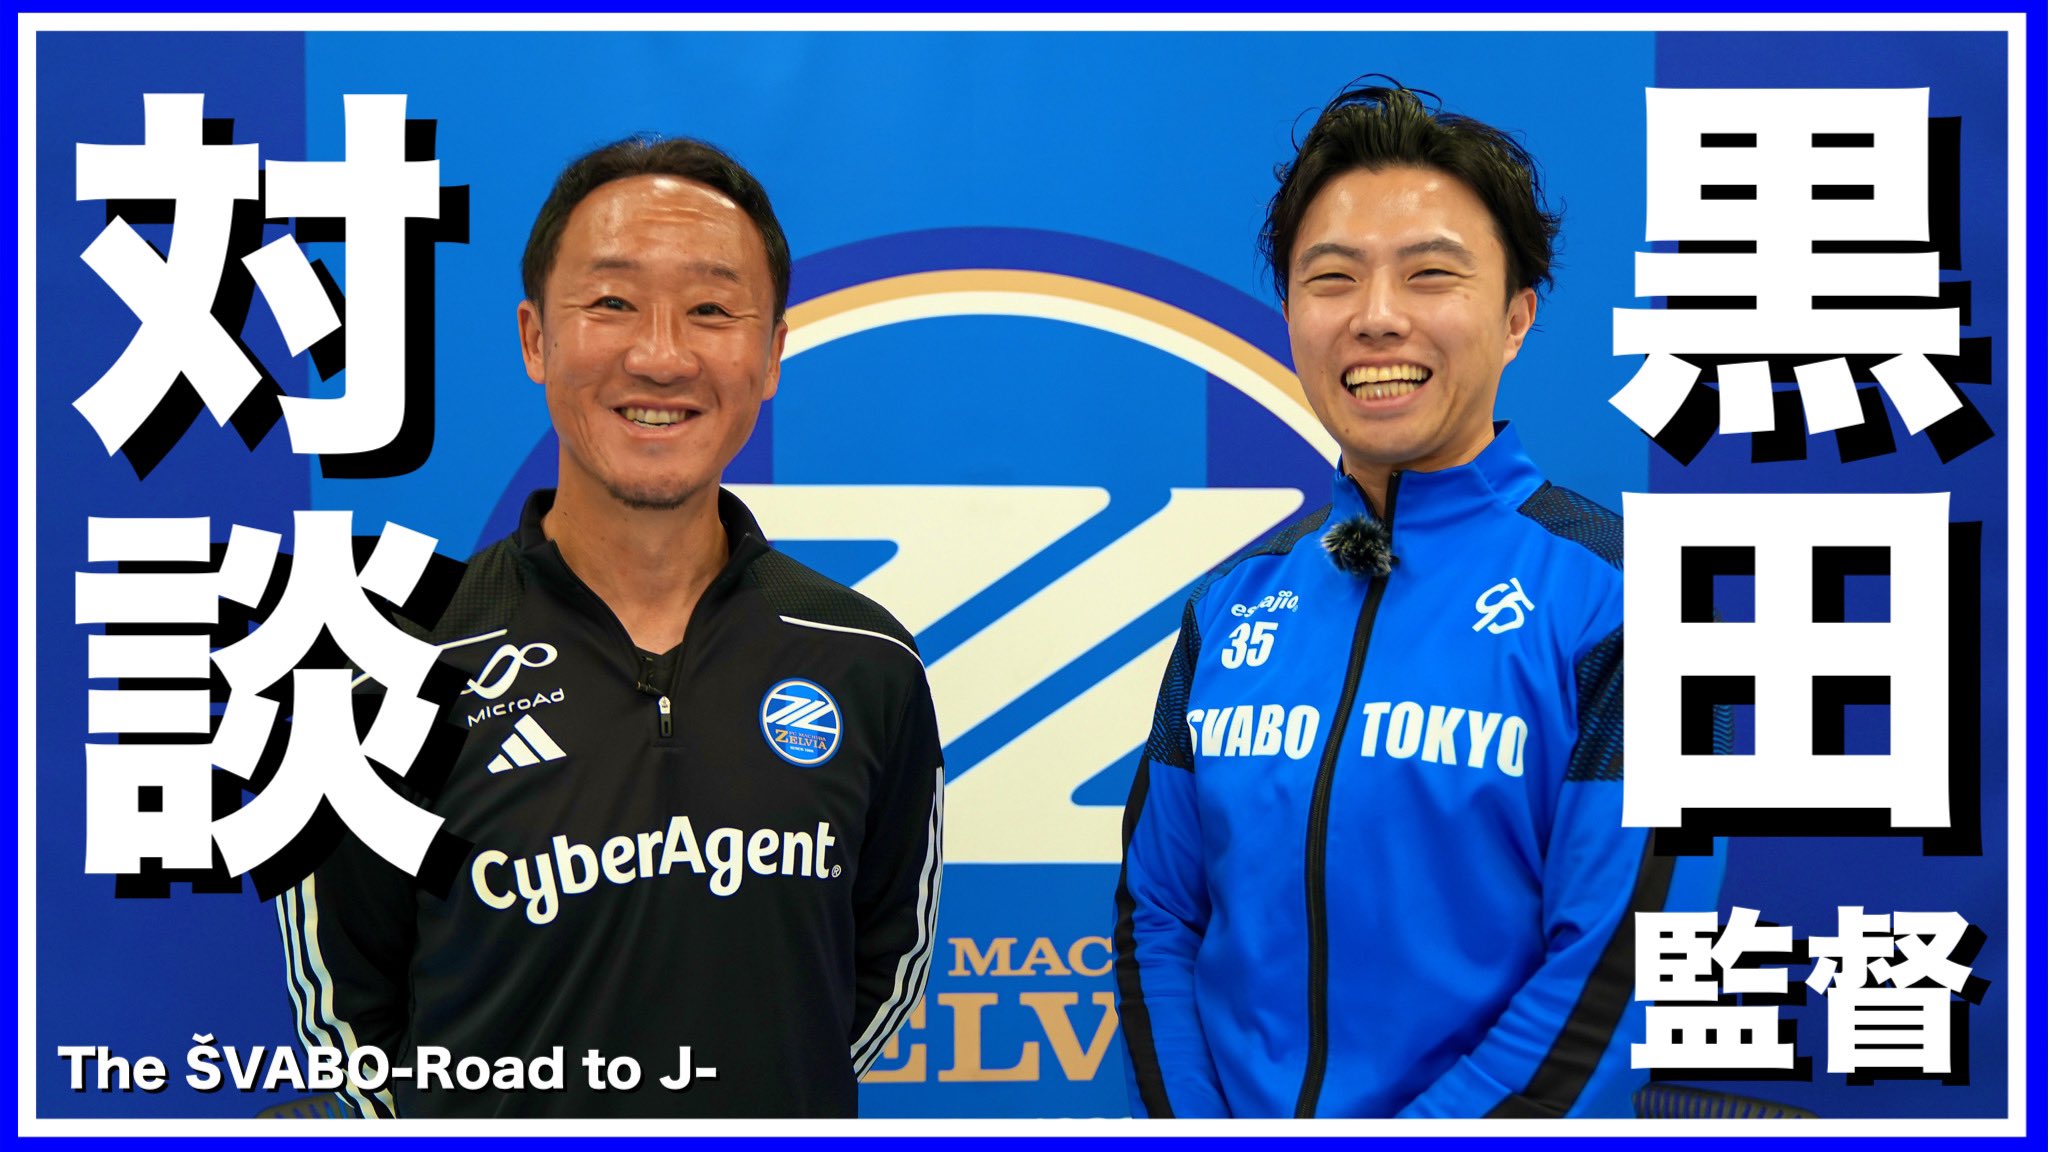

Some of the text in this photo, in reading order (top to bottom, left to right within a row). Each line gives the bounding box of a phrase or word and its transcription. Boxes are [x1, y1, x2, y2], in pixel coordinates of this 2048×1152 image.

[1231, 590, 1299, 617] esajio
[1221, 621, 1279, 669] 35
[467, 688, 565, 727] MicroAd
[775, 728, 828, 751] ZELVIA
[1186, 701, 1528, 777] SVABO TOKYO
